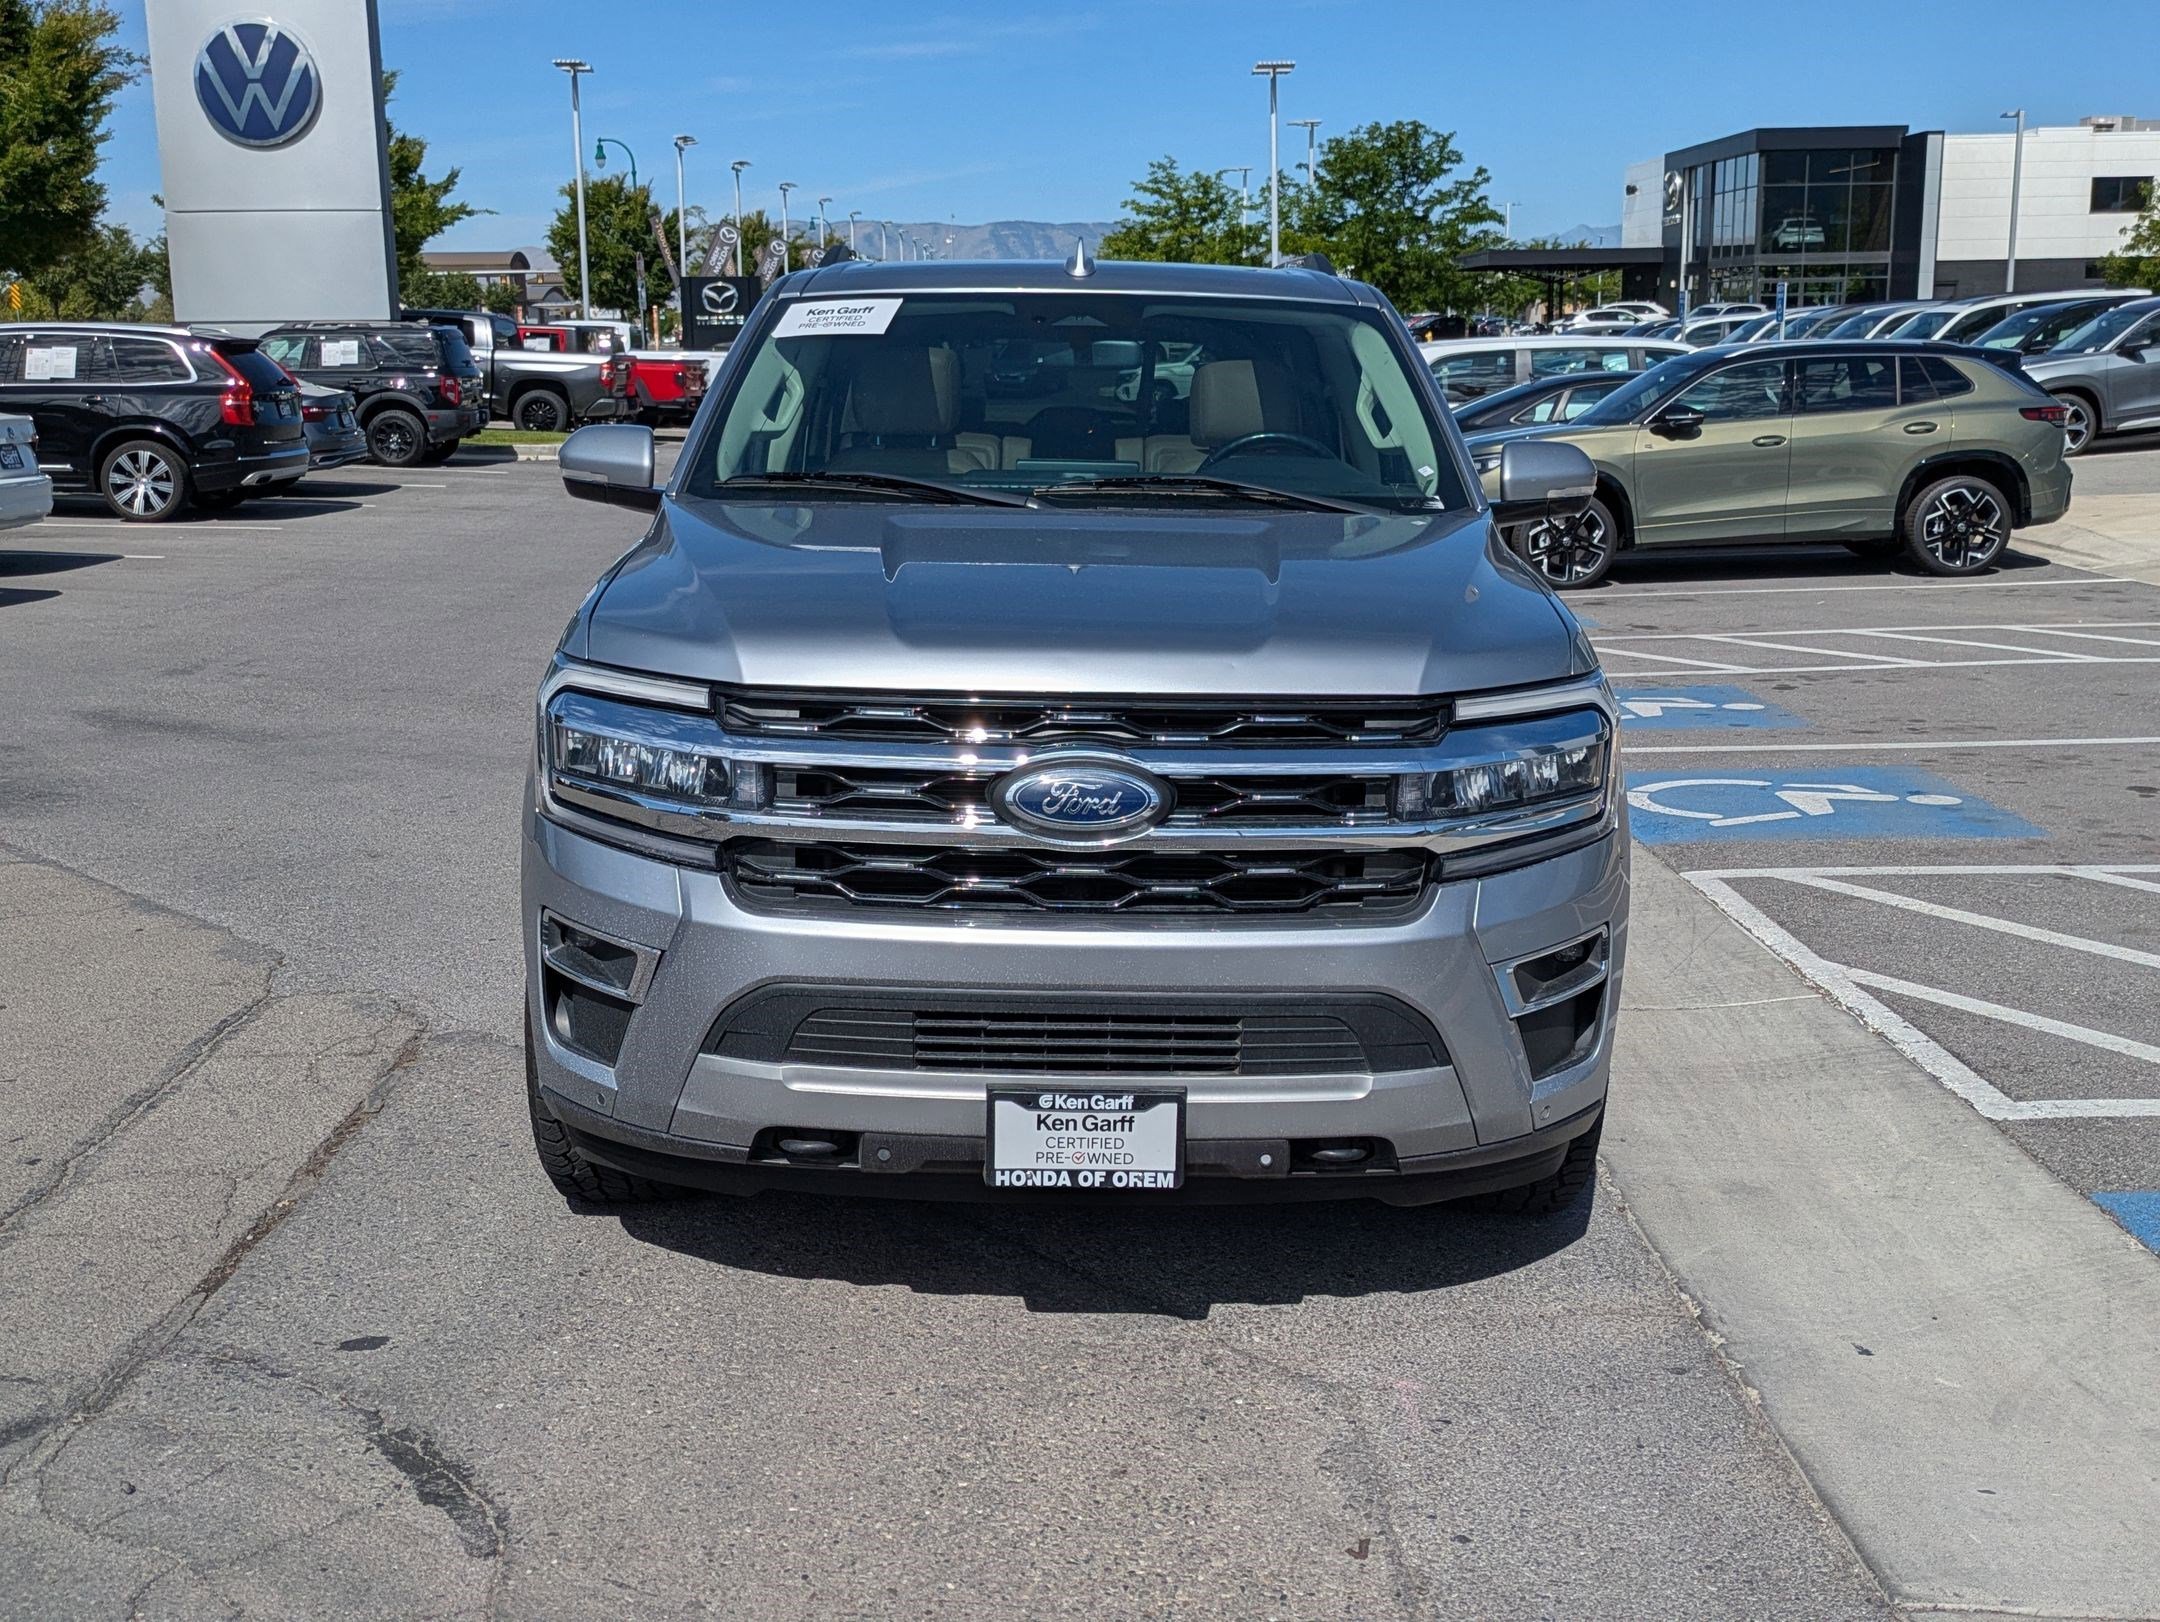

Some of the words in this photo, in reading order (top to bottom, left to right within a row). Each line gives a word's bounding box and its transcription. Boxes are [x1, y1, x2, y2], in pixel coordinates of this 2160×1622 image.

[199, 22, 310, 132] VW
[713, 245, 731, 275] MAZDA
[806, 307, 836, 316] Ken
[836, 305, 875, 314] Garff
[808, 314, 863, 323] CERTIFIED
[798, 320, 866, 329] PRE-OWNED
[1041, 781, 1123, 816] Ford
[1054, 1094, 1089, 1110] Ken
[1090, 1094, 1135, 1110] Garff
[1036, 1113, 1078, 1132] Ken
[1082, 1114, 1135, 1133] Garff
[1045, 1136, 1125, 1150] CERTIFIED
[1035, 1151, 1134, 1165] PRE-OWNED
[995, 1169, 1072, 1187] HONDA
[1078, 1170, 1106, 1188] OF
[1112, 1171, 1174, 1189] OREM
